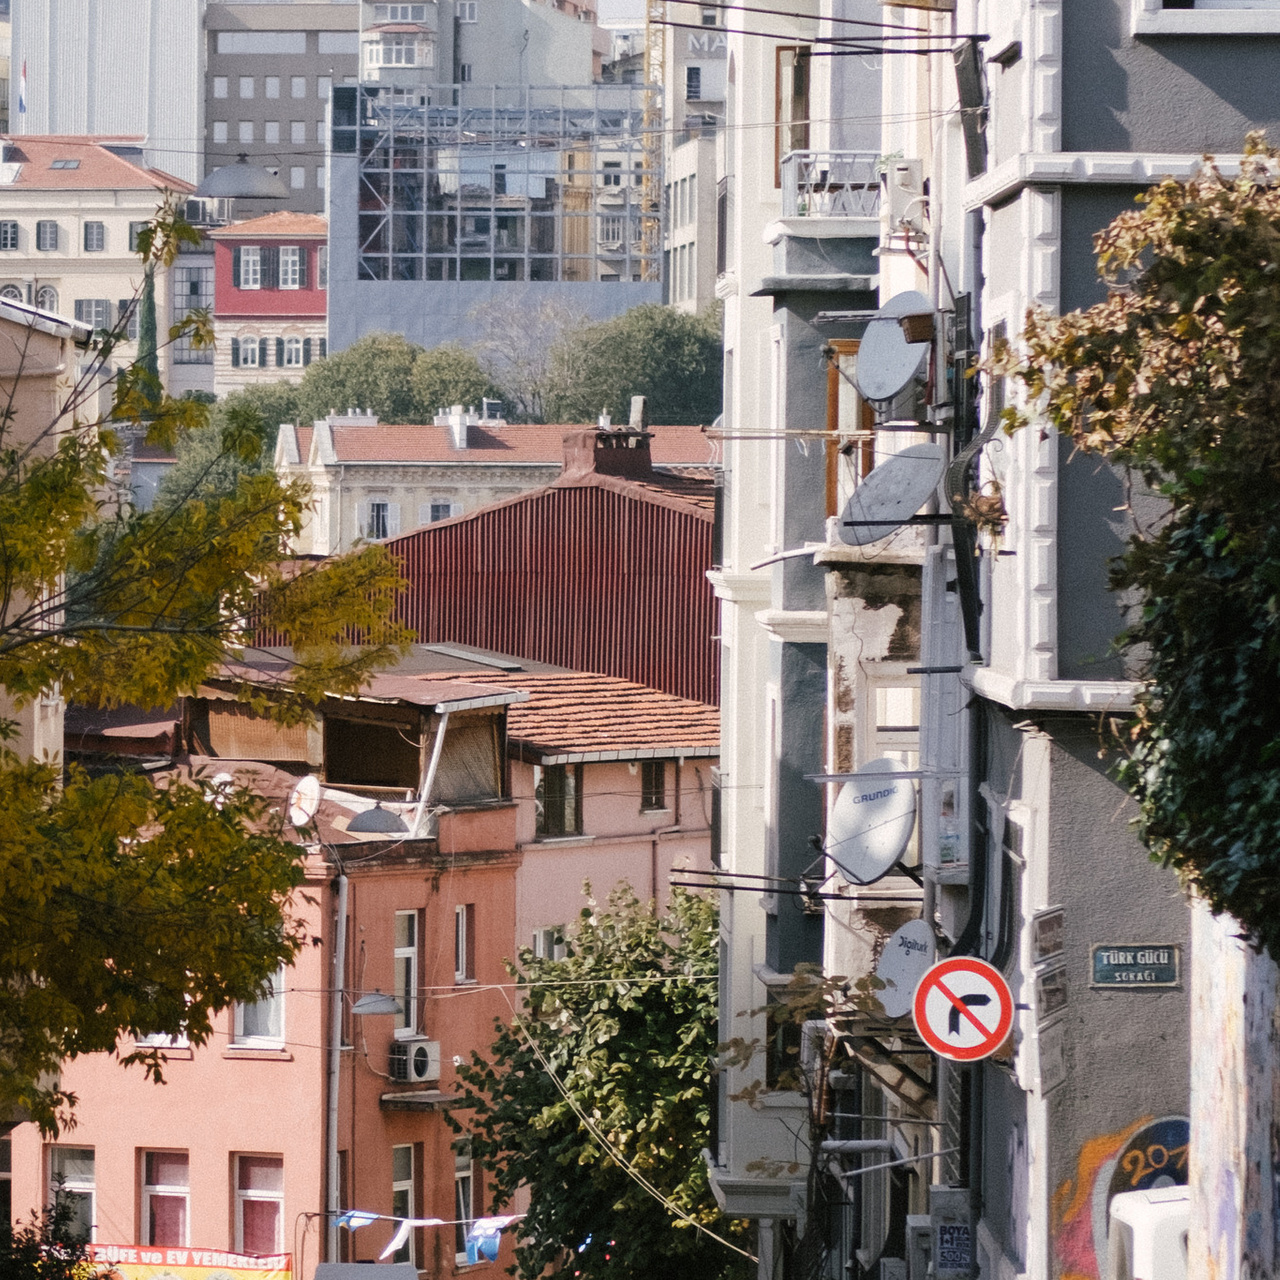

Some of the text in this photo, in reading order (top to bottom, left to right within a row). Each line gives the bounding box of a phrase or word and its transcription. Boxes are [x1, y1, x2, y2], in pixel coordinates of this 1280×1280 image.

[1101, 949, 1169, 964] TÜRK GÜCÜ
[1114, 970, 1156, 982] SOKAĞI
[940, 1225, 970, 1236] BOYA
[94, 1246, 138, 1263] BÜFE
[166, 1250, 189, 1265] EV
